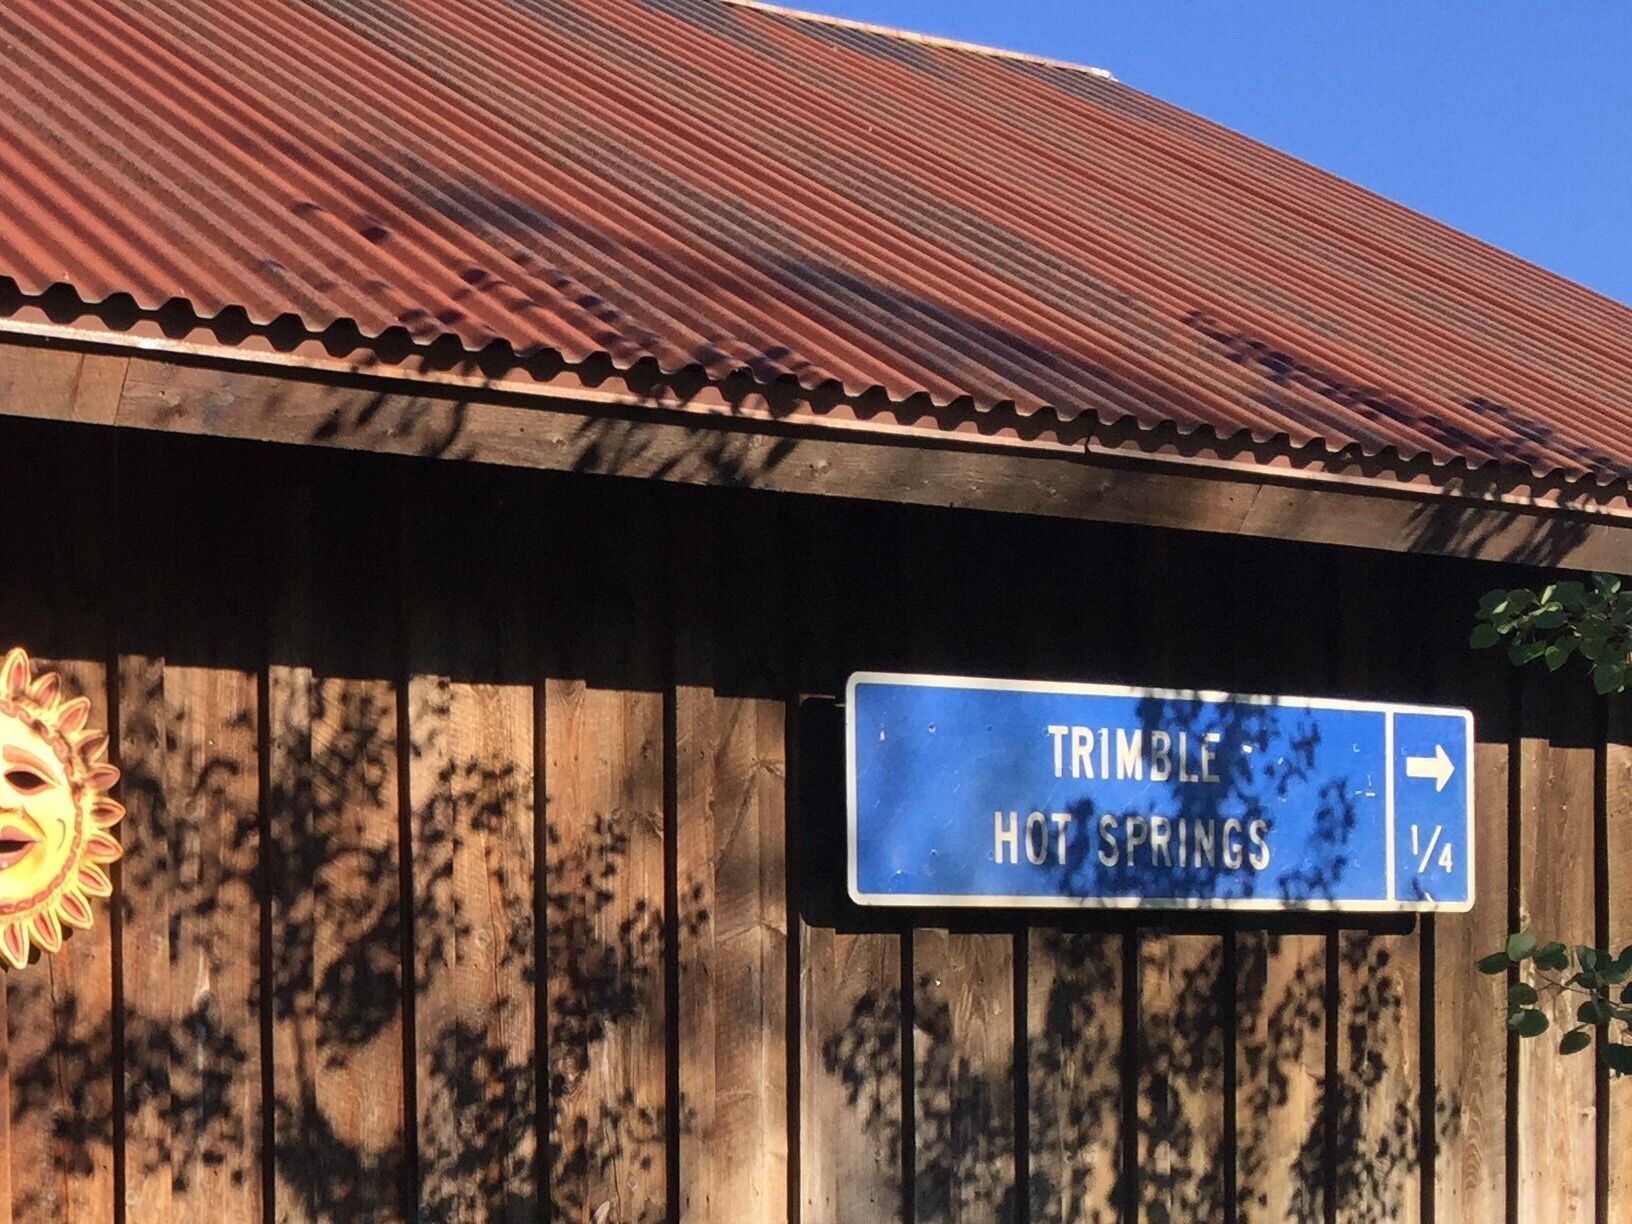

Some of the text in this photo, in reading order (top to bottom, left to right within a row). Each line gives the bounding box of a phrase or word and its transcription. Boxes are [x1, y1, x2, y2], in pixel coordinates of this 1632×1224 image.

[1047, 725, 1221, 784] TRIMBLE
[993, 811, 1271, 871] HOT SPRINGS
